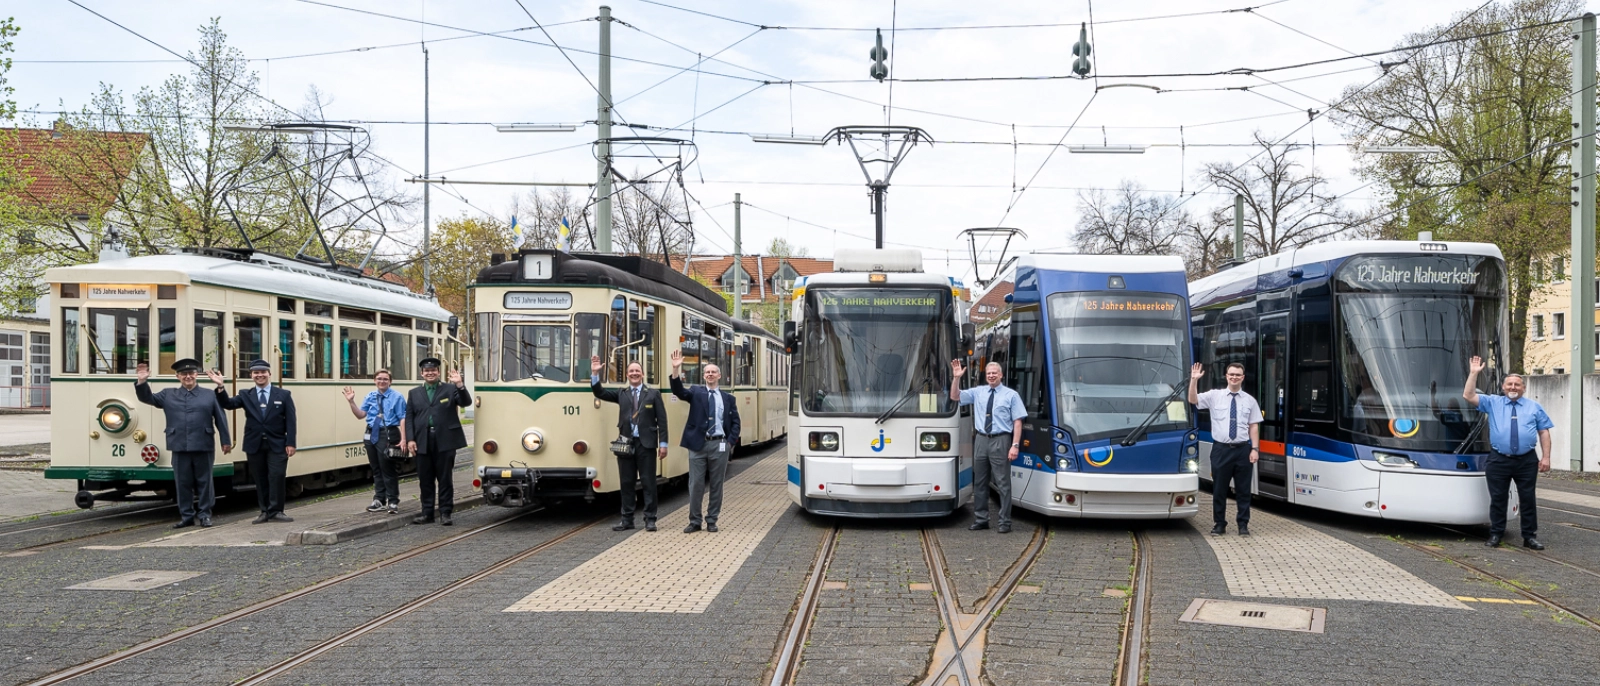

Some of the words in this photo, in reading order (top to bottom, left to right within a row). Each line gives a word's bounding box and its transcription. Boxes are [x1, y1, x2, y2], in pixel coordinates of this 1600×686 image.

[536, 260, 542, 276] 1
[1357, 265, 1375, 282] 125
[1377, 265, 1411, 283] Jahre
[1413, 265, 1480, 285] Nahverkehr
[92, 287, 102, 295] 125
[103, 287, 117, 295] Jahre
[117, 287, 147, 295] Nahverkehr
[511, 296, 521, 304] 125
[522, 296, 537, 304] Jahre
[537, 296, 569, 305] Nahverkehr
[823, 297, 838, 306] 125
[842, 297, 870, 306] JAHRE
[873, 297, 936, 306] NAHVERKEHR
[1083, 300, 1098, 310] 125
[1100, 300, 1125, 310] Jahre
[1126, 300, 1175, 311] Nahverkehr
[562, 405, 580, 415] 101
[112, 443, 126, 457] 26
